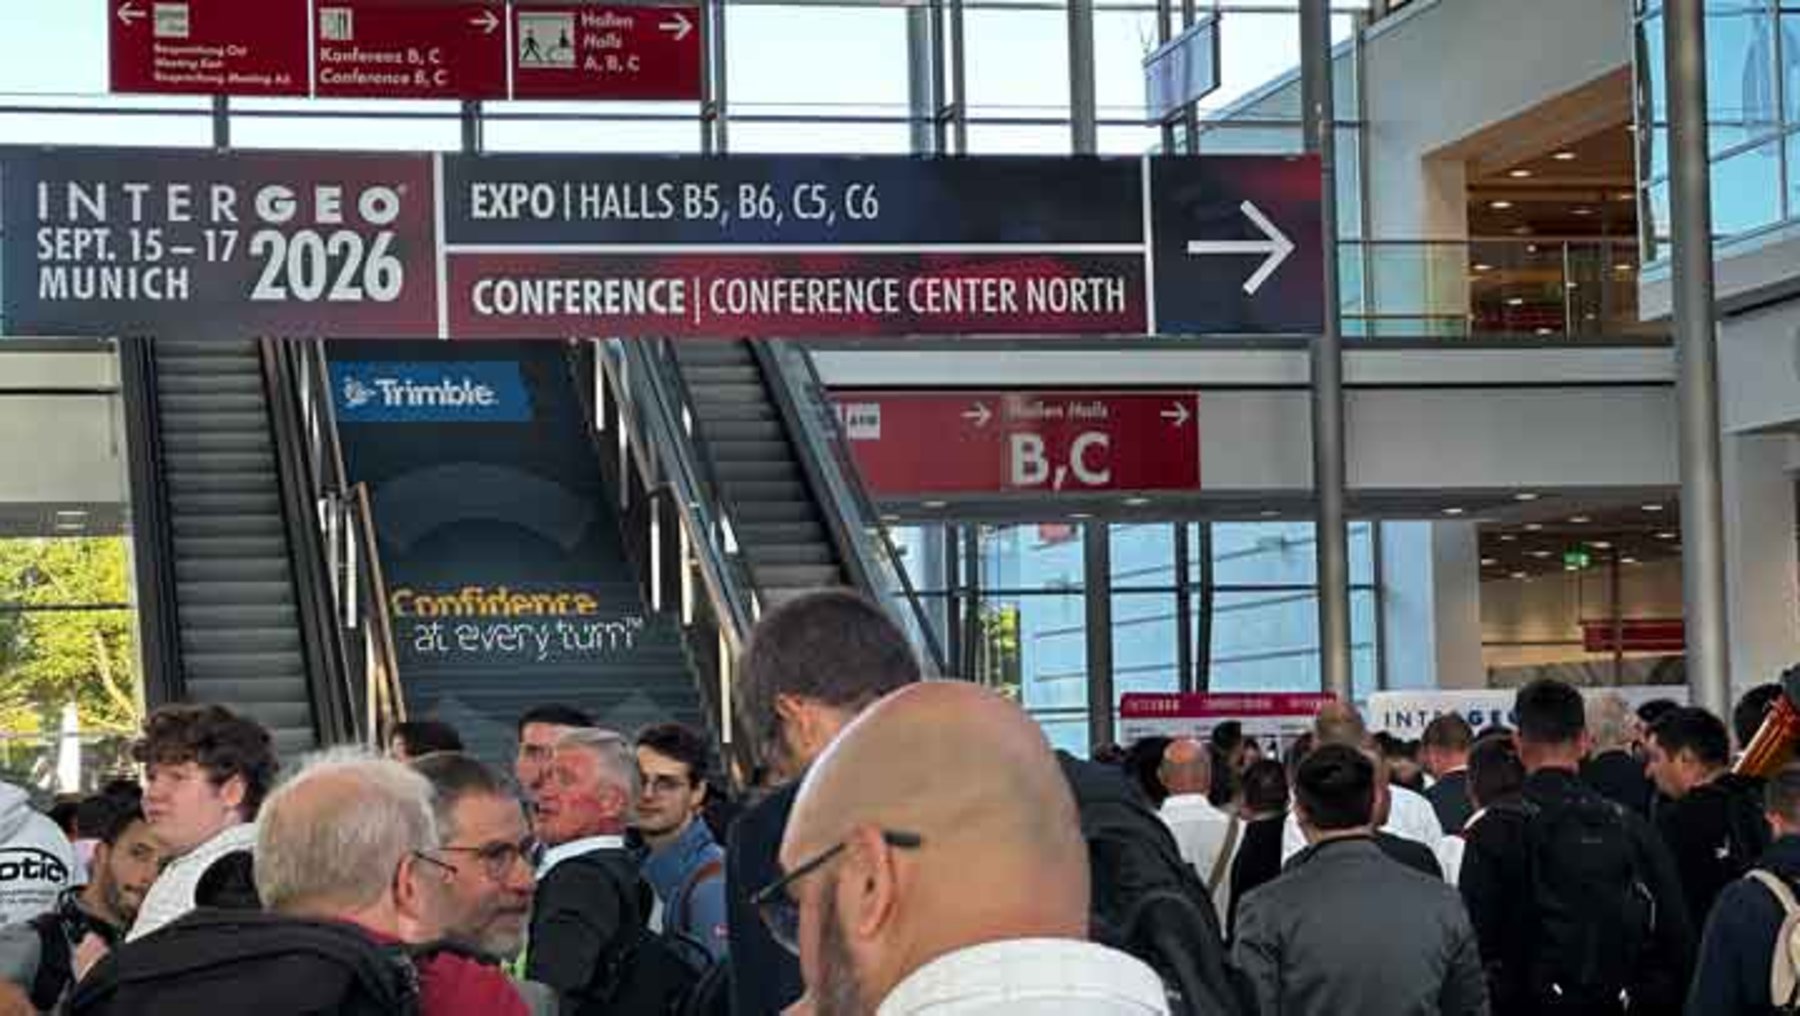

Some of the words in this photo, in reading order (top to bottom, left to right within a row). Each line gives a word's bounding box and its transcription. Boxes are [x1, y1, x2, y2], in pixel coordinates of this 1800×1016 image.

[428, 49, 441, 64] C
[627, 56, 640, 71] C
[320, 68, 410, 84] Conference
[433, 70, 447, 86] C
[37, 181, 401, 225] INTERGEO
[471, 182, 556, 219] EXPO
[580, 182, 674, 219] HALLS
[684, 183, 729, 226] B5,
[739, 183, 783, 226] B6,
[794, 183, 835, 226] C5,
[845, 183, 879, 219] C6
[37, 227, 115, 261] SEPT.
[249, 229, 403, 301] 2026
[38, 266, 189, 300] MUNICH
[472, 279, 686, 315] CONFERENCE
[709, 277, 900, 315] CONFERENCE
[908, 277, 1017, 314] CENTER
[1027, 277, 1126, 313] NORTH
[374, 376, 496, 406] Trimble
[1009, 432, 1110, 490] B,C
[391, 586, 599, 617] Confidence
[414, 621, 449, 651] at
[454, 622, 550, 661] every
